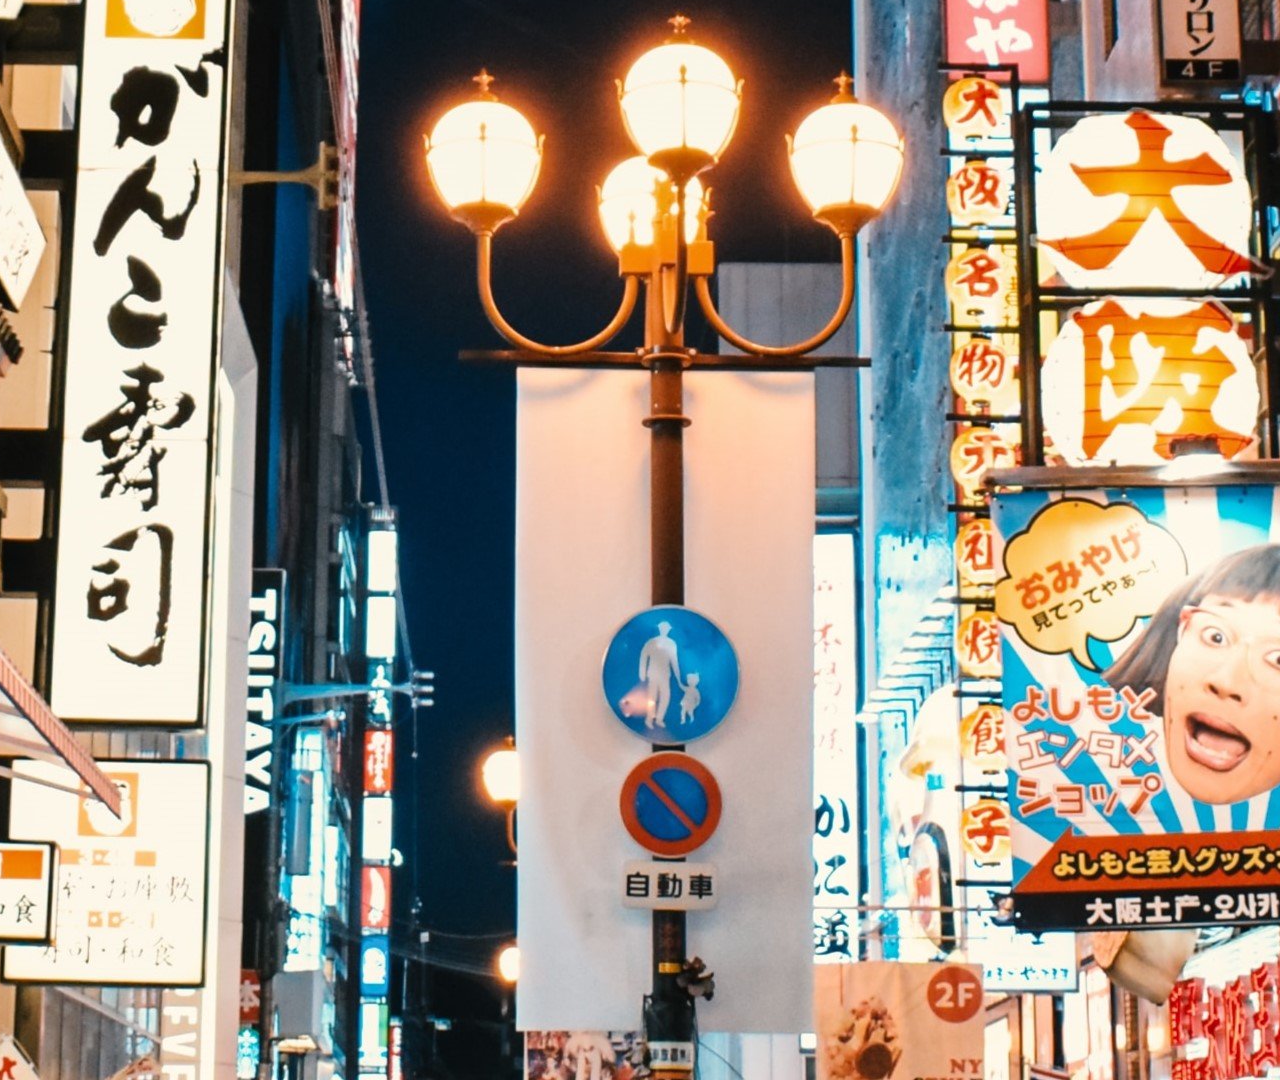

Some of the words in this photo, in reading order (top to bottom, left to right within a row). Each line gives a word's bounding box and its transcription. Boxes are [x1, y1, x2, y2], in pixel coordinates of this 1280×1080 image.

[1036, 111, 1270, 461] 大阪
[1015, 520, 1144, 610] おみやげ
[244, 588, 277, 815] TSUTAYA
[1012, 685, 1158, 723] よしもと
[1017, 732, 1158, 769] エンタメ
[1017, 777, 1162, 817] ショップ
[626, 872, 713, 898] 自動車
[934, 981, 977, 1009] 2F
[950, 1059, 983, 1074] NY
